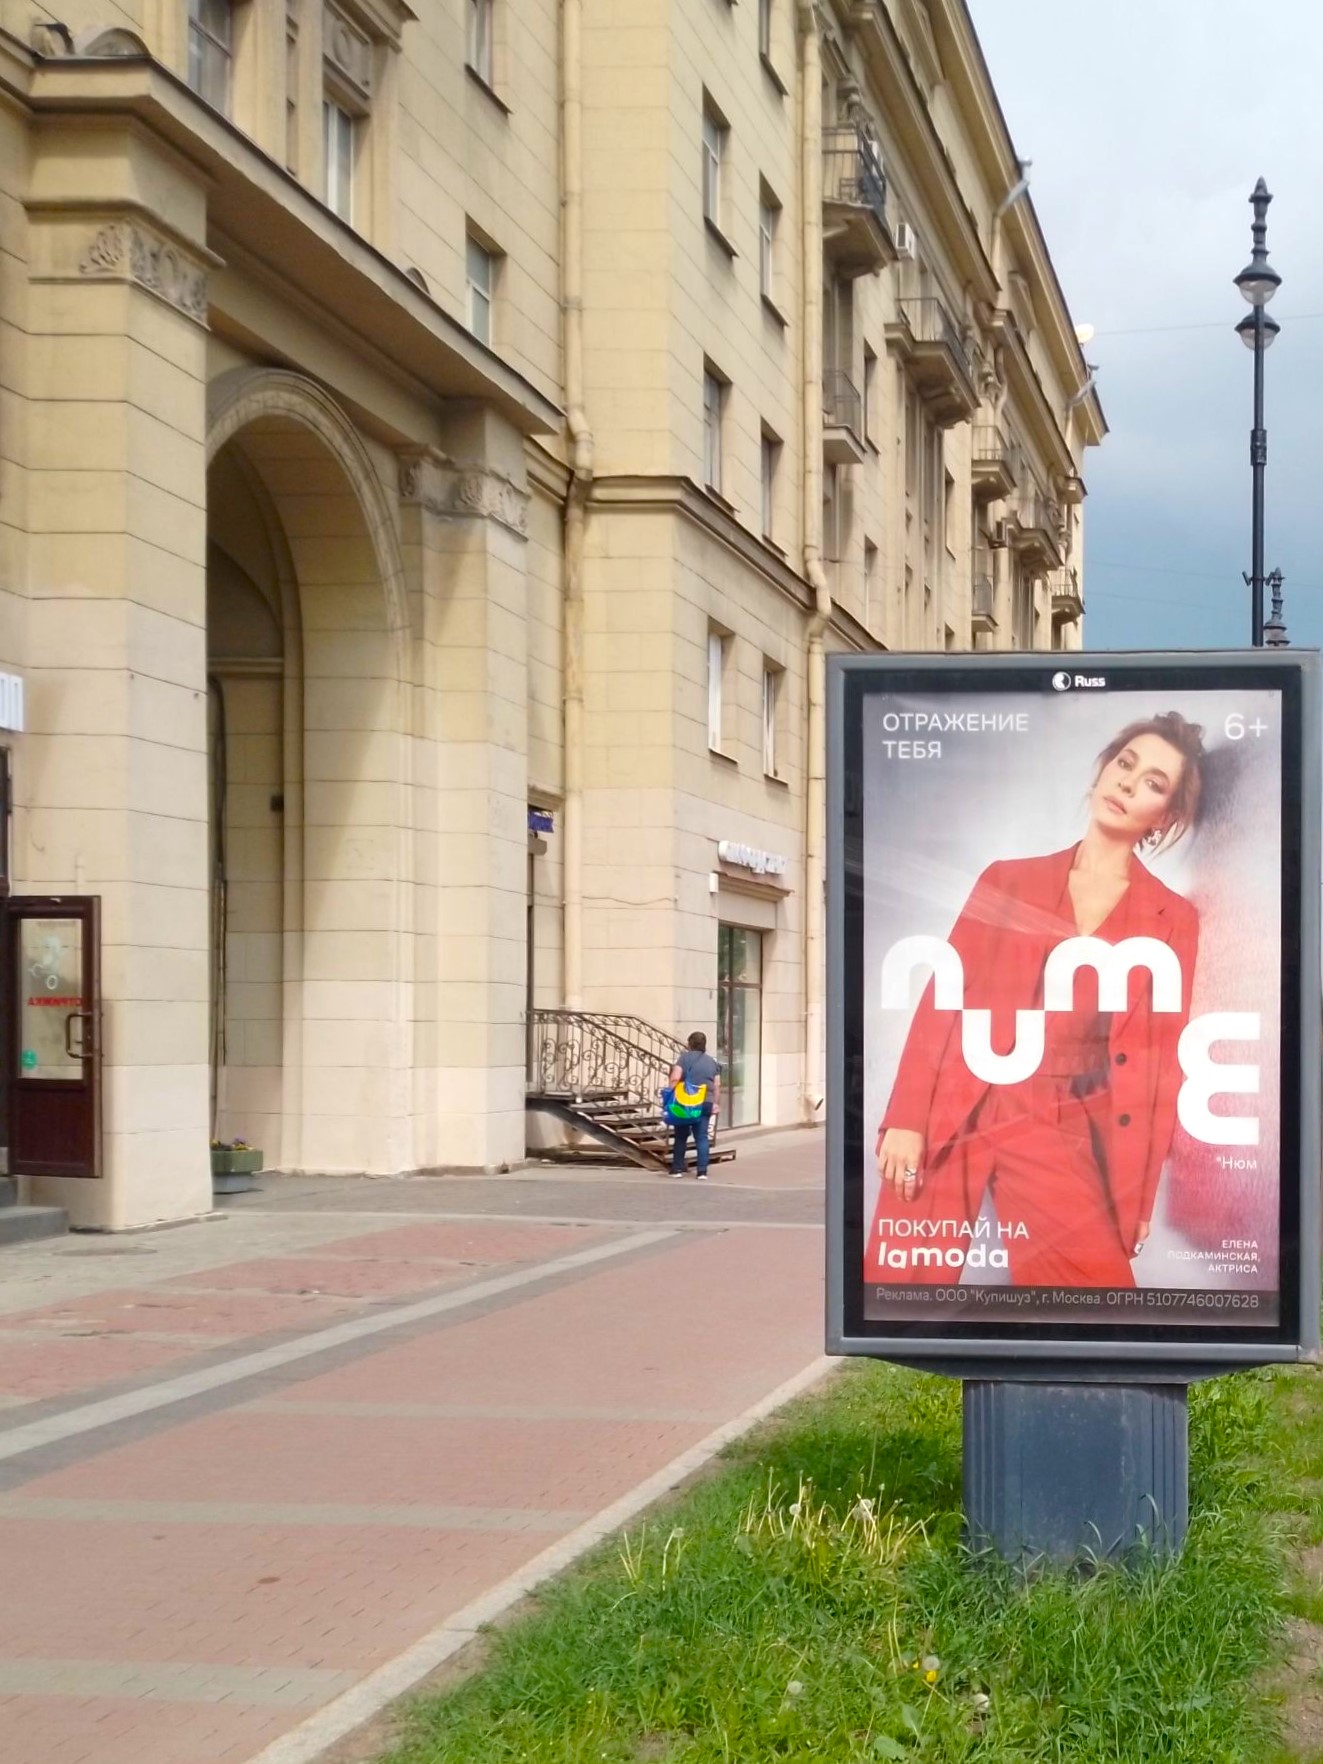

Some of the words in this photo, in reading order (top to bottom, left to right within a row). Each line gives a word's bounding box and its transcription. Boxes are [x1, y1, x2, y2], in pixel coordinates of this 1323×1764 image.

[1074, 675, 1106, 688] Russ
[882, 713, 1029, 732] ОТРАЖЕНИЕ
[1223, 713, 1269, 740] 6+
[882, 740, 942, 759] ТЕБЯ
[878, 1217, 990, 1238] ПОКУПАЙ
[997, 1221, 1029, 1240] НА
[1222, 1239, 1258, 1249] ЕЛЕНА
[878, 1241, 1009, 1268] lamoda
[1167, 1250, 1261, 1262] ПОДКАМИНСКАЯ,
[1208, 1263, 1258, 1273] АКТРИСА
[876, 1287, 933, 1302] Реклама.
[935, 1288, 967, 1302] ООО
[1106, 1291, 1144, 1306] ОГРН
[1147, 1293, 1260, 1308] 5107746007628
